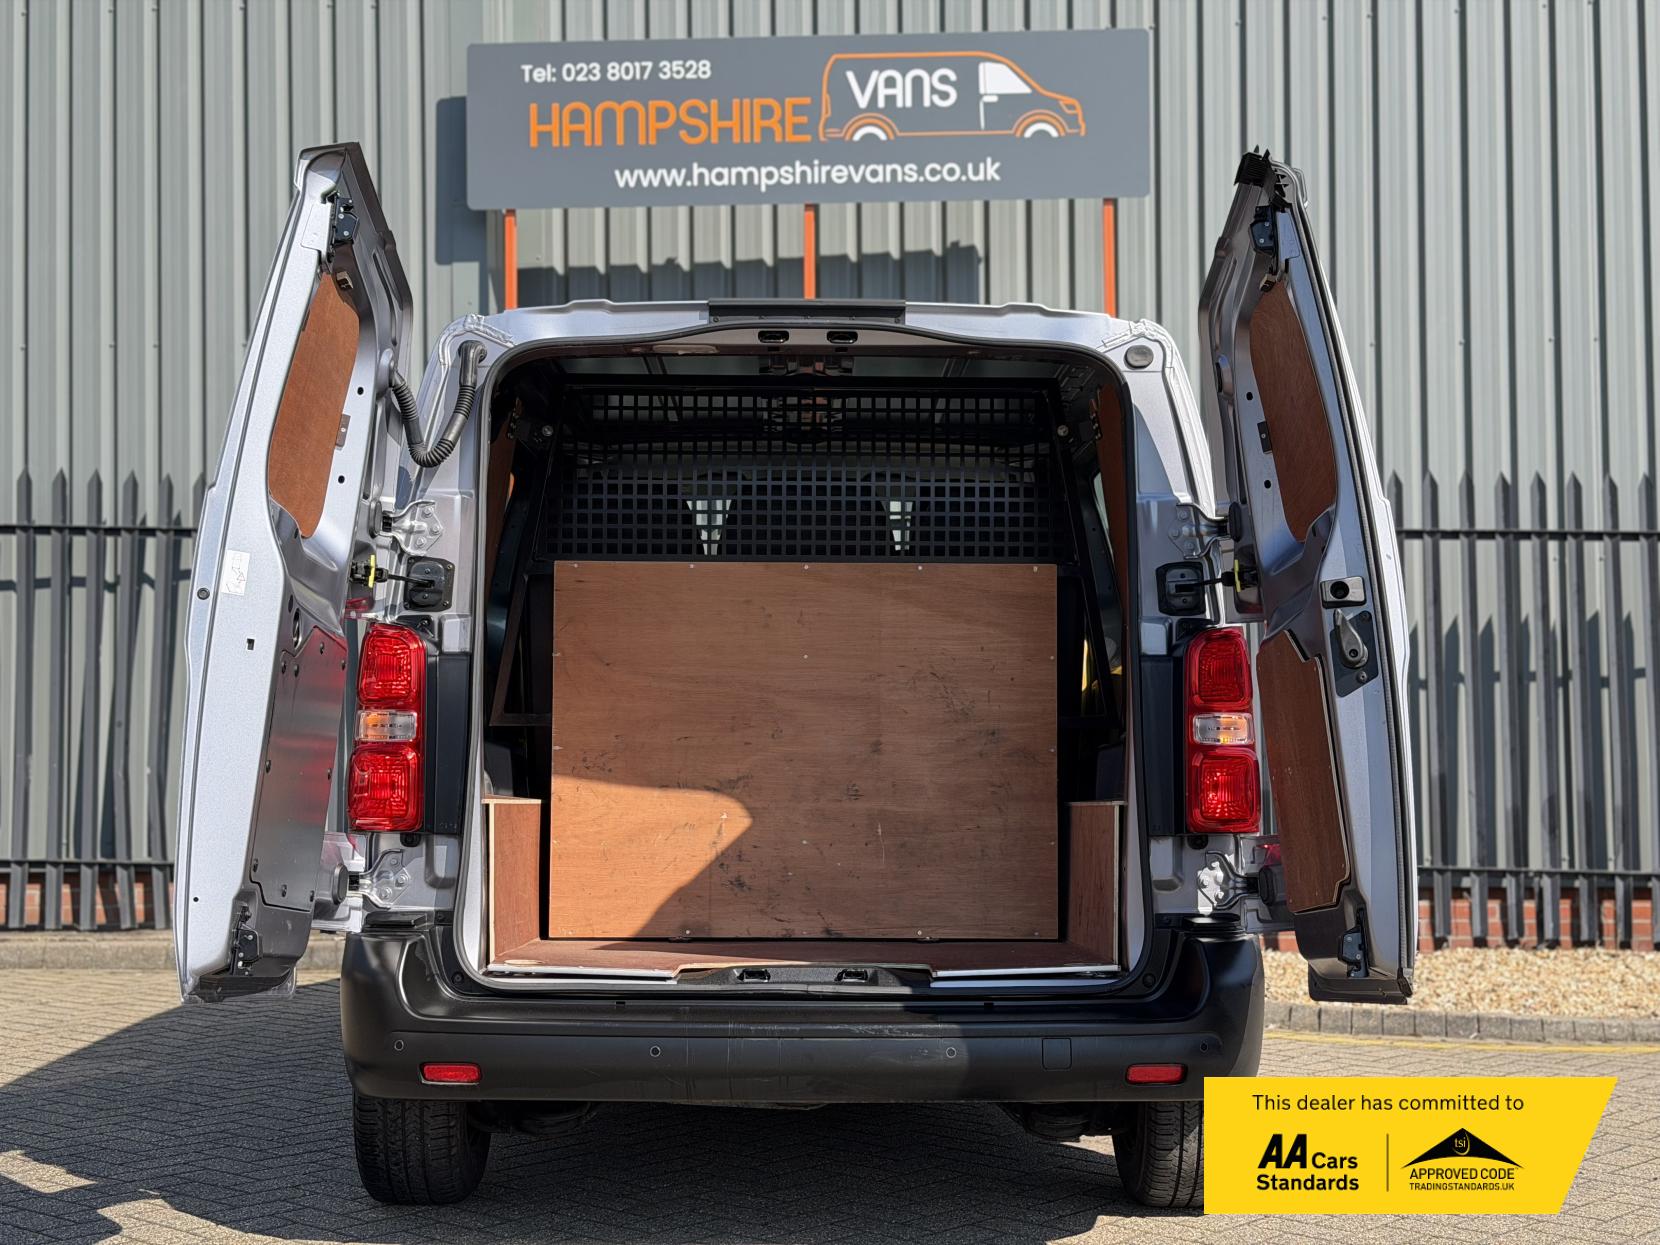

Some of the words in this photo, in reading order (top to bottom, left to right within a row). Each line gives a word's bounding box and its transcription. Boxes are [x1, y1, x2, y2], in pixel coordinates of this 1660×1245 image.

[521, 63, 557, 83] Tel:
[561, 62, 601, 82] 023
[607, 61, 653, 82] 8017
[658, 59, 712, 80] 3528
[529, 96, 812, 148] HAMPSHIRE
[845, 67, 958, 109] VANS
[615, 156, 1001, 193] www.hampshirevans.co.uk
